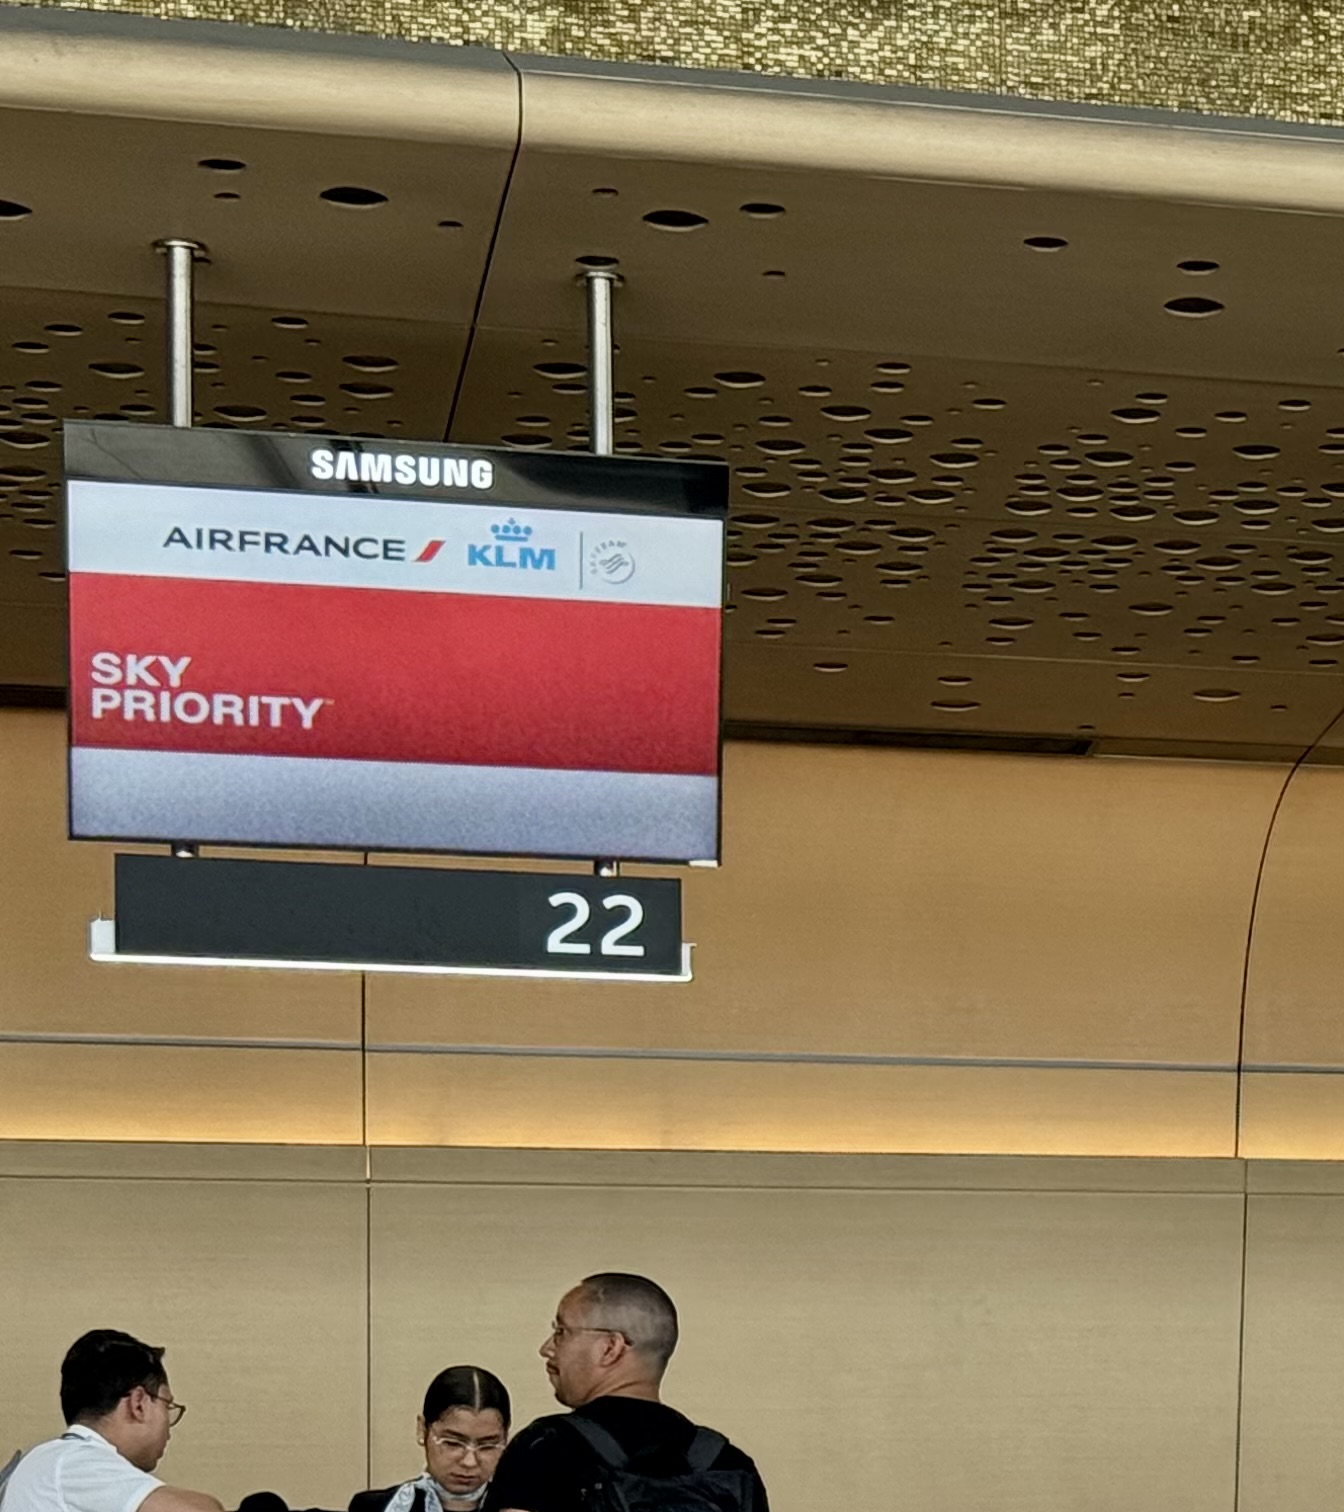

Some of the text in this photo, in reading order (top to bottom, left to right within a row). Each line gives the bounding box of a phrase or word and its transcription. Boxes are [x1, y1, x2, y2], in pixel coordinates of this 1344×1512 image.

[311, 449, 494, 490] SAMSUNG
[163, 526, 406, 562] AIRFRANCE
[467, 543, 556, 571] KLM
[91, 652, 191, 688] SKY
[91, 687, 323, 730] PRIORITY
[547, 891, 645, 957] 22
